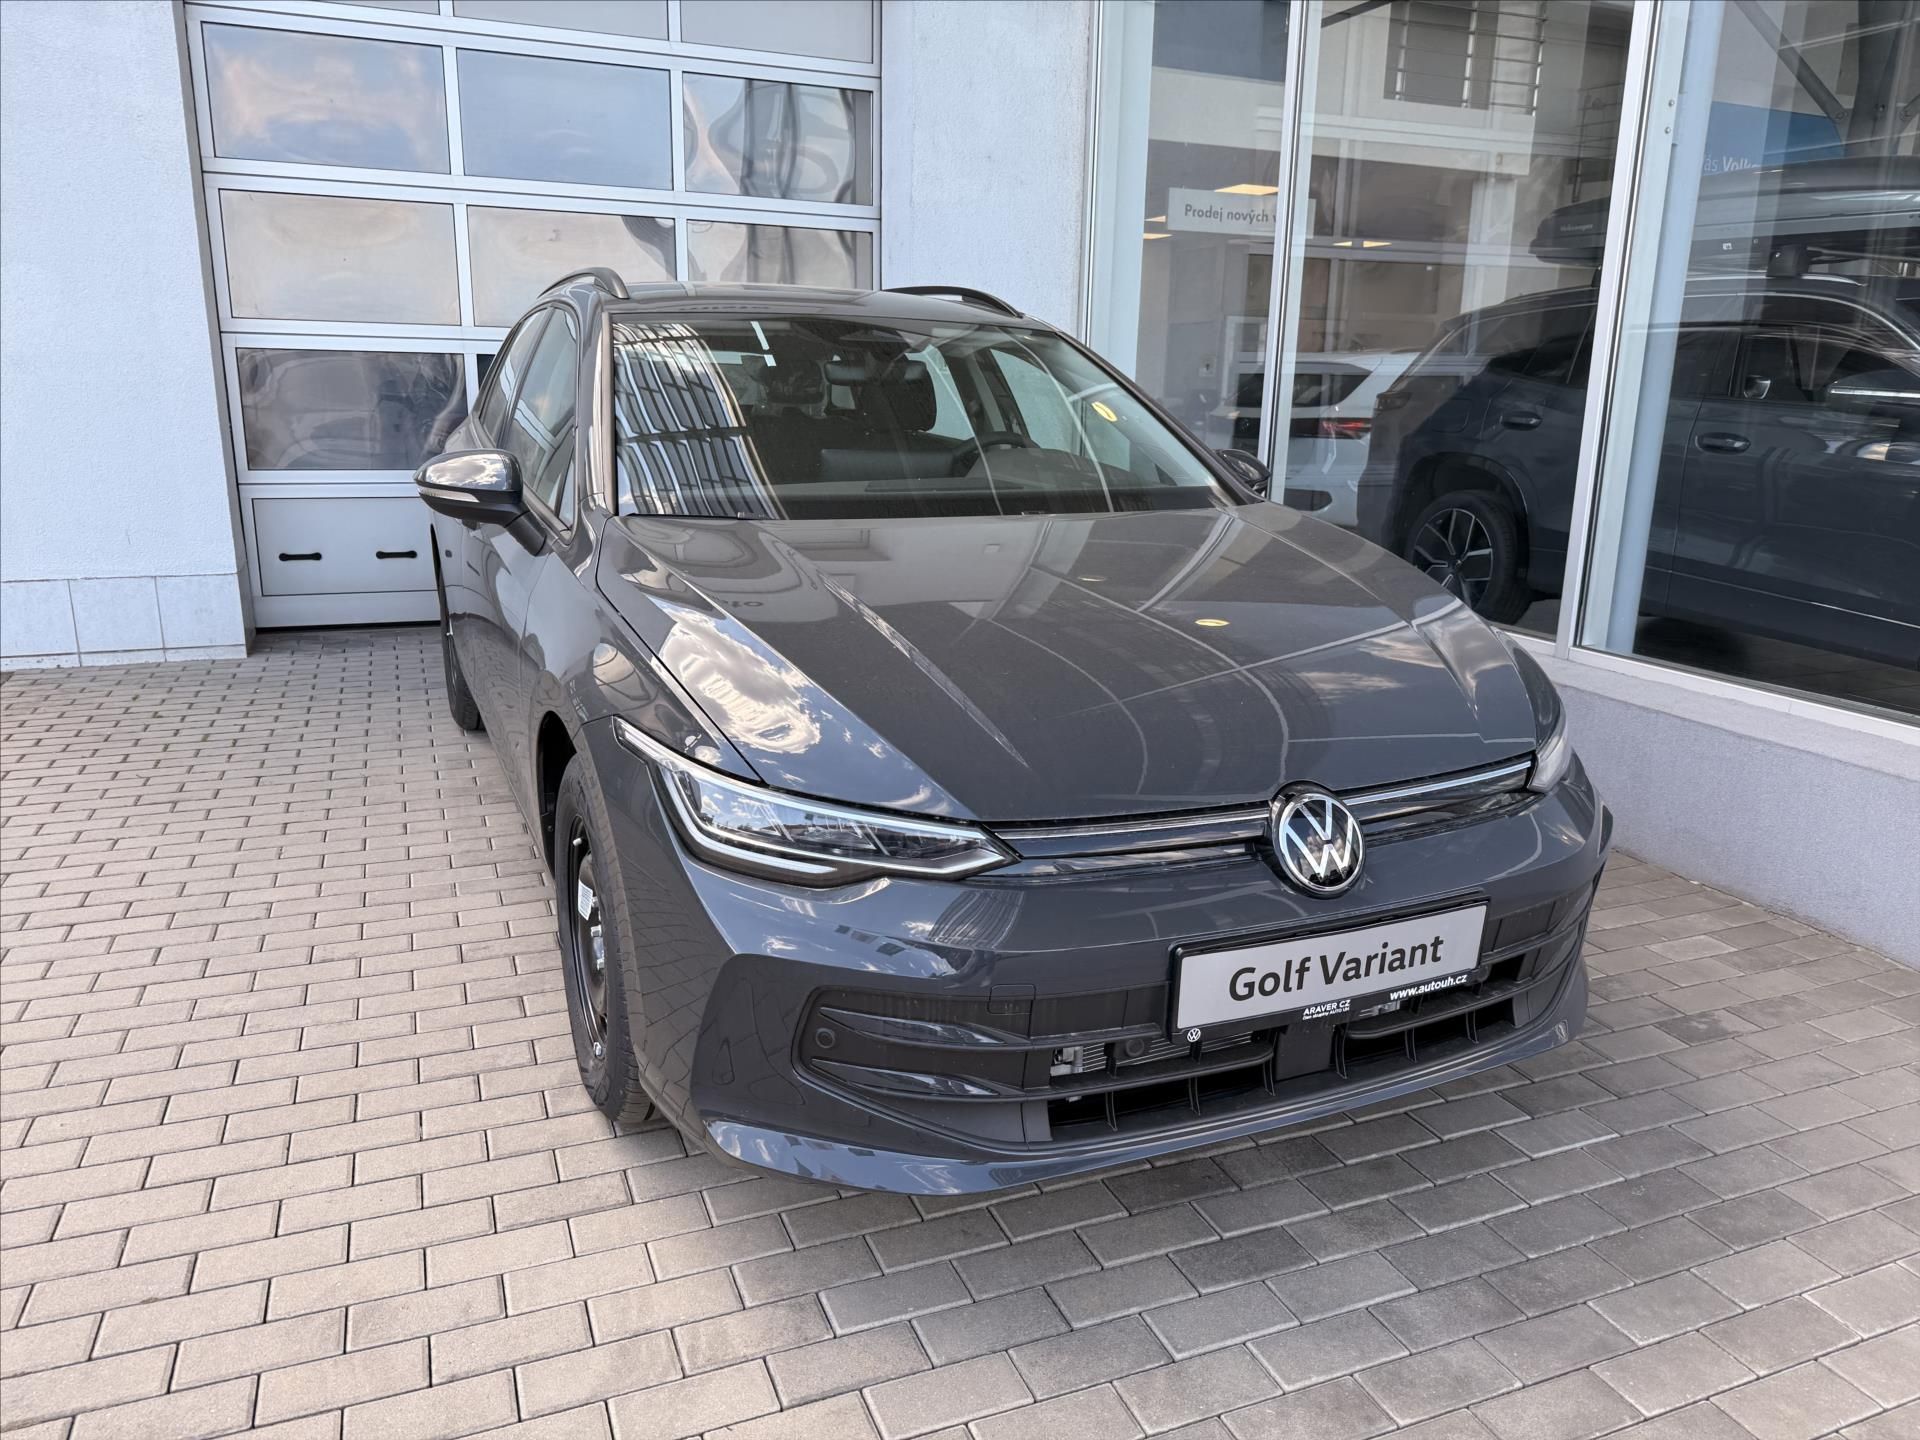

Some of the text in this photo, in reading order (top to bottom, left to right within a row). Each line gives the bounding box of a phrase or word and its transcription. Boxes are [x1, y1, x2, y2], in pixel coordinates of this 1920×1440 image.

[1184, 203, 1223, 222] Prodej
[1226, 209, 1269, 224] nových
[1229, 935, 1444, 1002] Golf Variant
[1389, 974, 1468, 1001] www.autouh.cz
[1303, 999, 1351, 1016] ARAVER CZ
